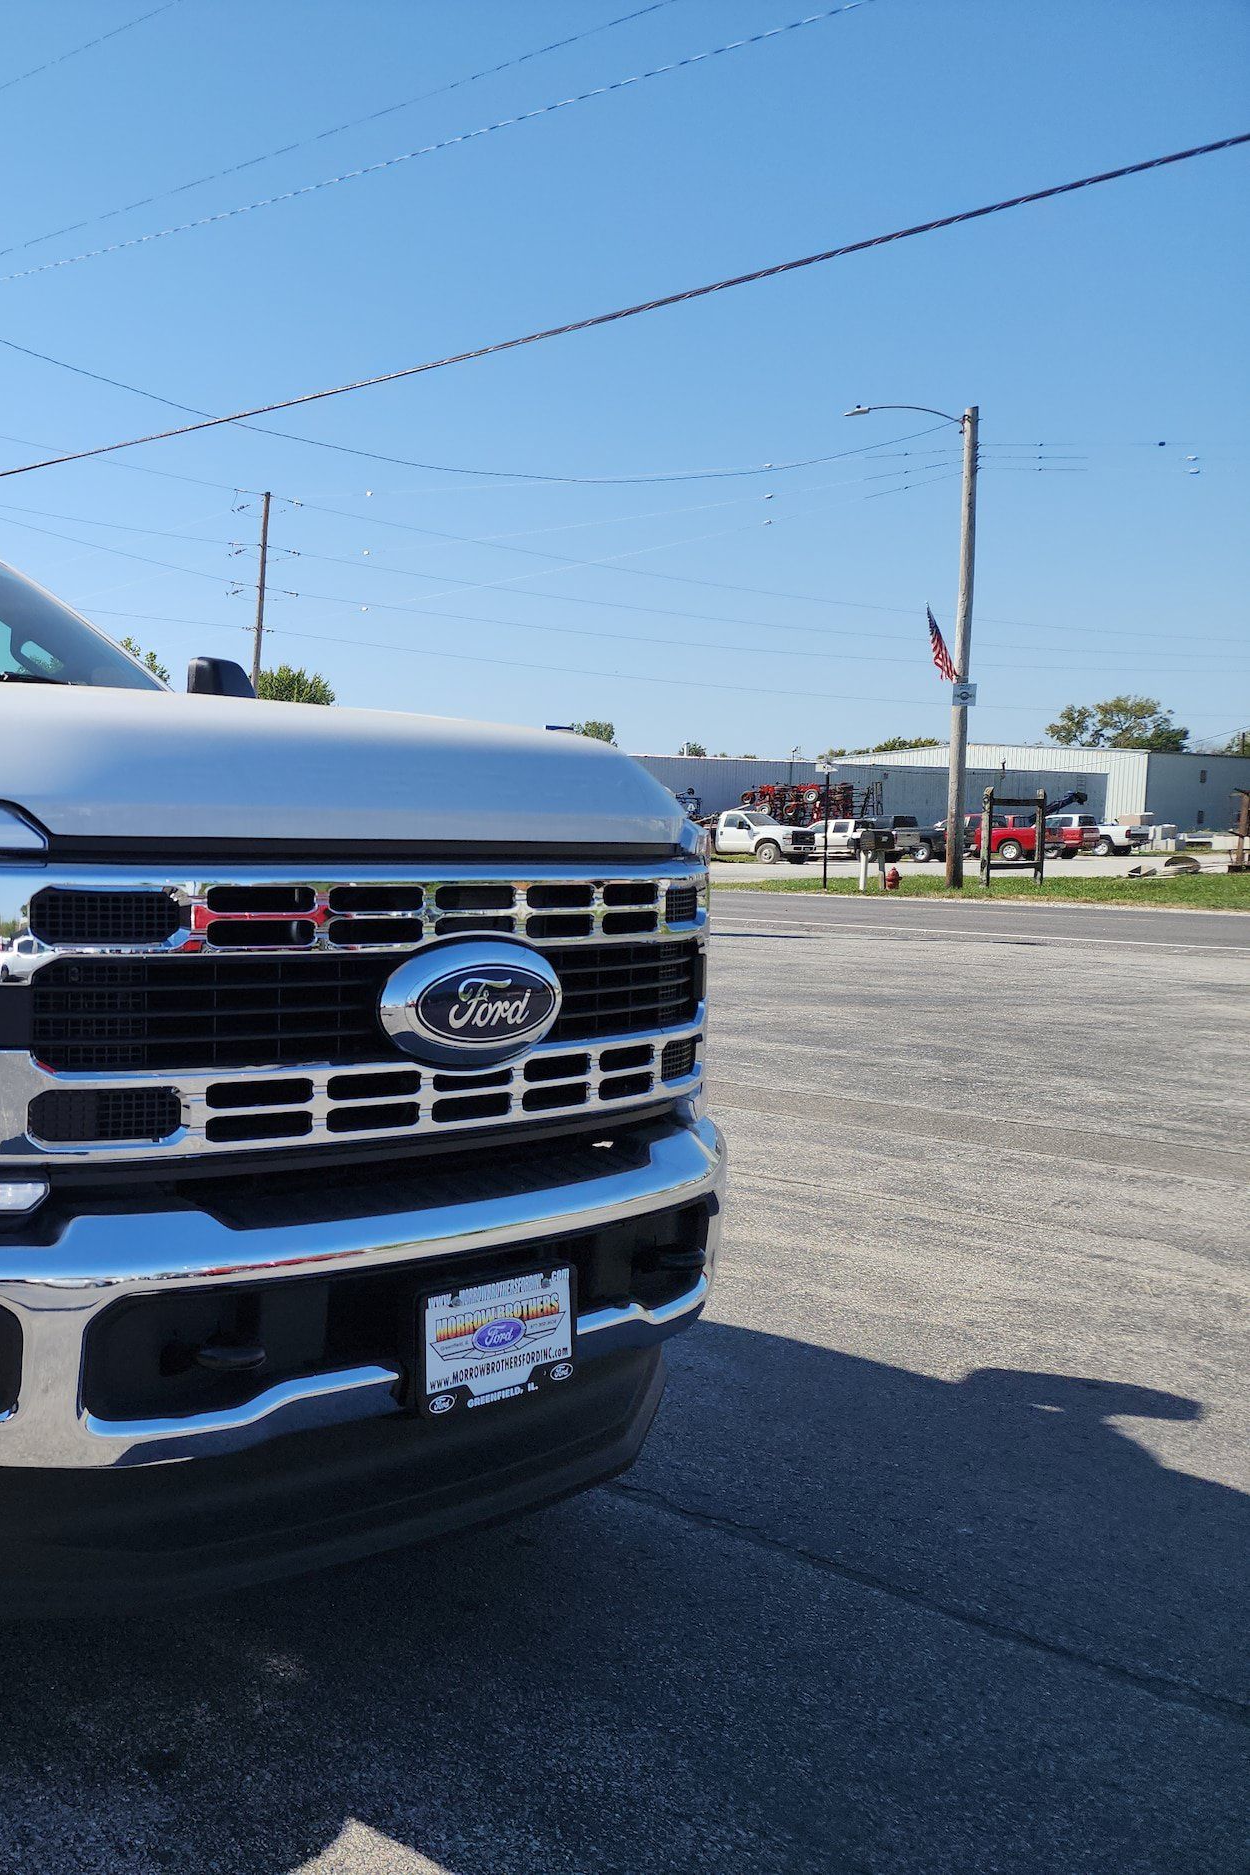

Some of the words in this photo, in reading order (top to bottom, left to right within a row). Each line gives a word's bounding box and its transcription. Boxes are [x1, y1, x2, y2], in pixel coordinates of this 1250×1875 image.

[449, 978, 532, 1029] Ford
[436, 1306, 496, 1341] MORROW
[497, 1292, 559, 1321] BROTHERS
[485, 1325, 514, 1346] Ford
[554, 1365, 569, 1378] Ford
[433, 1397, 451, 1411] Ford
[467, 1386, 523, 1408] GREENFIELD,
